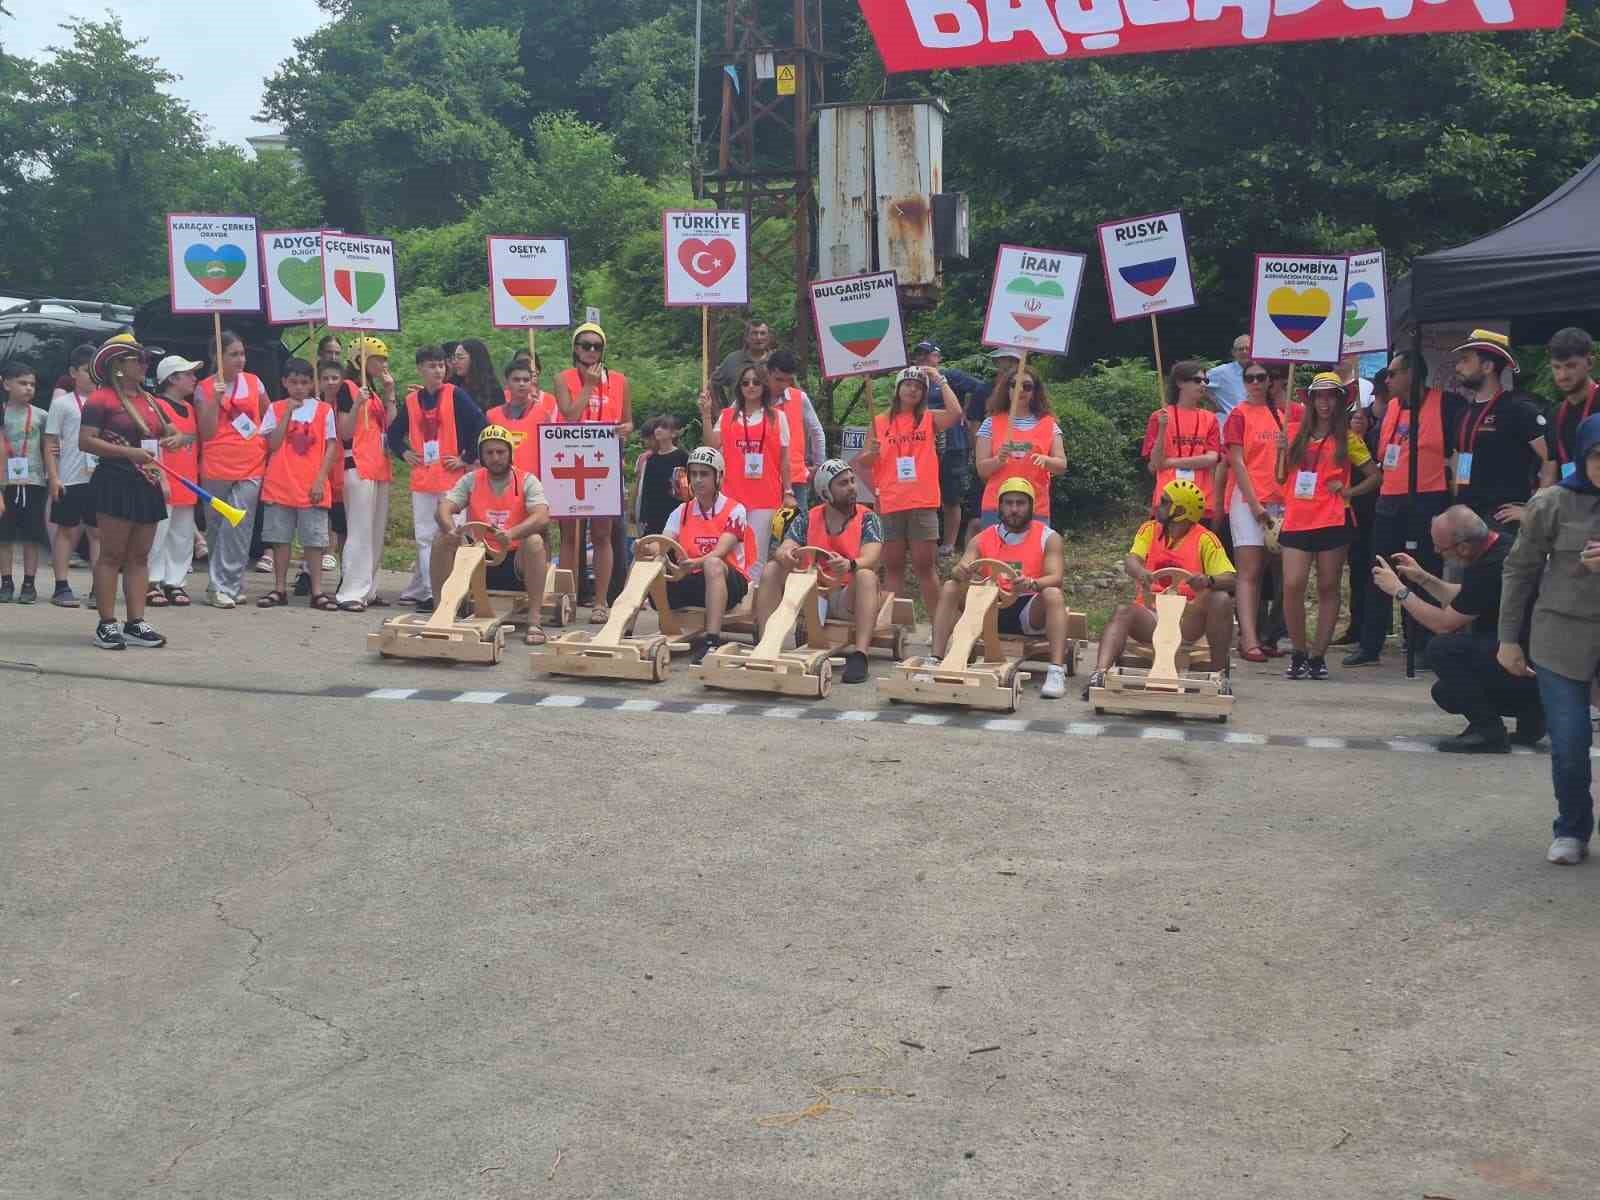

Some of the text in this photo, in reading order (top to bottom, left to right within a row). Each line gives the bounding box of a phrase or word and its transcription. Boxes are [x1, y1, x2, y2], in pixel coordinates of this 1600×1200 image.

[672, 212, 740, 229] TÜRKİYE
[1115, 219, 1168, 242] RUSYA
[273, 236, 321, 249] ADYGE
[325, 240, 390, 255] ÇEÇENİSTAN
[509, 245, 547, 254] OSETYA
[1020, 252, 1061, 273] İRAN
[1265, 261, 1338, 274] KOLOMBİYA
[814, 278, 893, 298] BULGARİSTAN
[544, 427, 614, 439] GÜRCİSTAN
